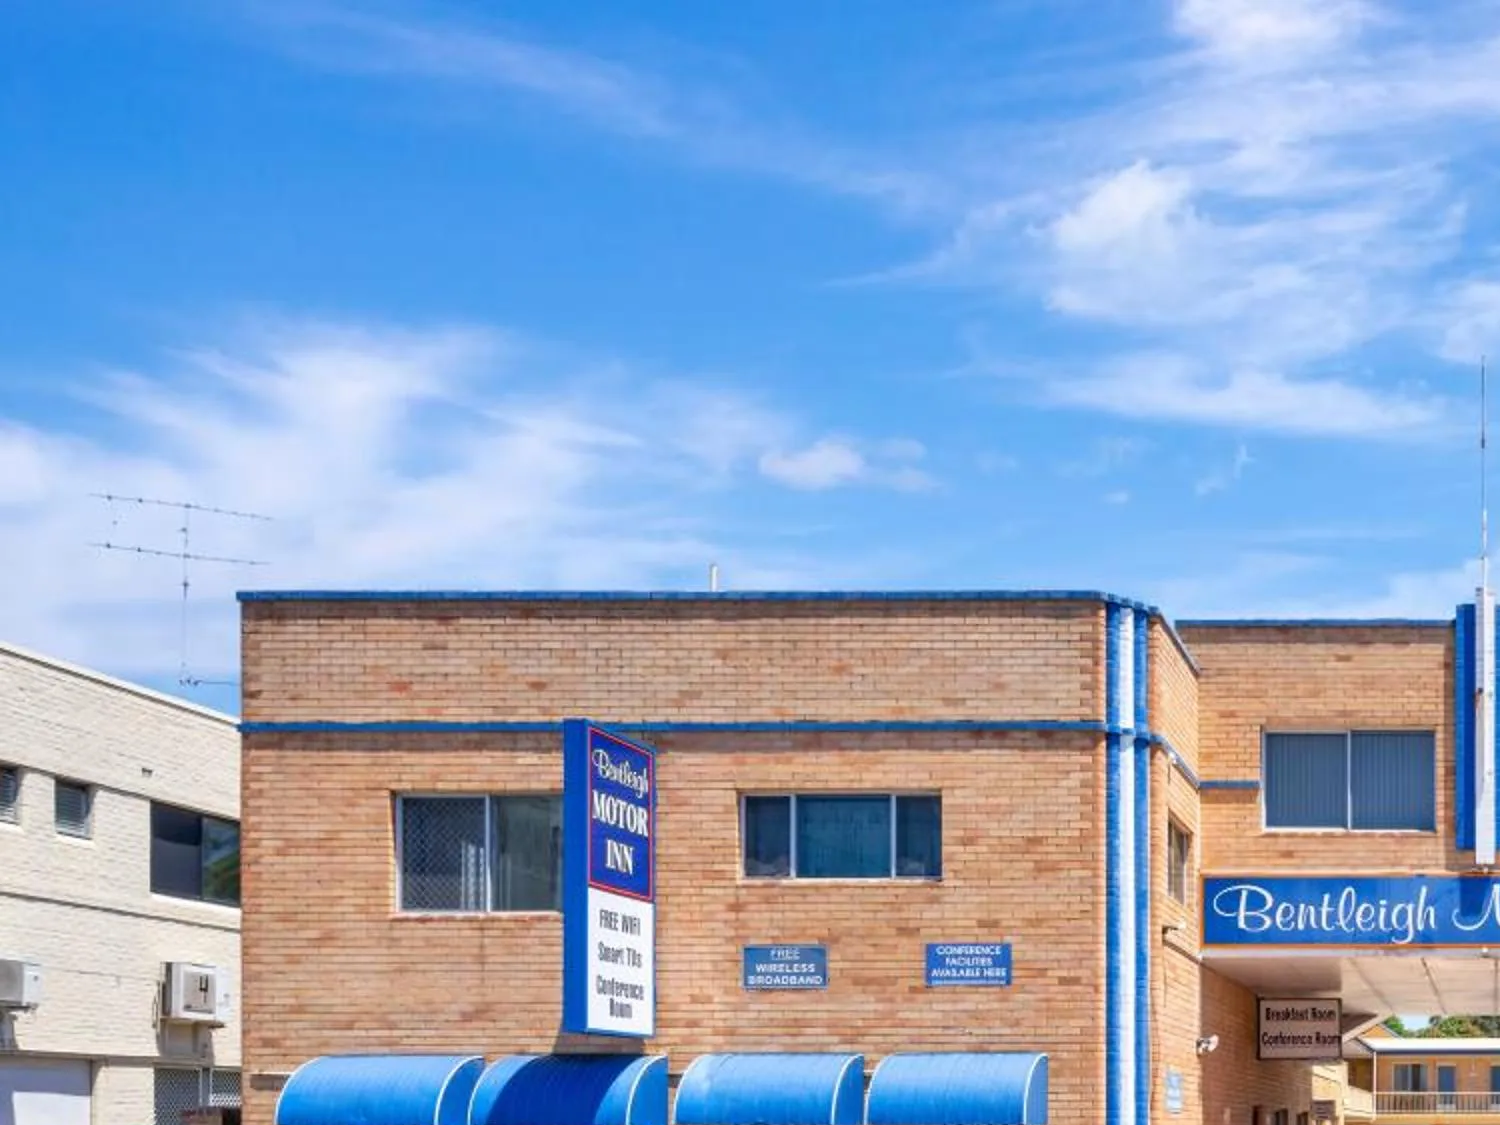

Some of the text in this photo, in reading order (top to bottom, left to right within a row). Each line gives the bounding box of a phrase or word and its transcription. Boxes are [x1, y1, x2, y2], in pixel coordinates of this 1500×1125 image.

[592, 749, 649, 798] Bentleigh
[592, 789, 649, 837] MOTOR
[605, 839, 634, 874] INN
[599, 908, 619, 931] FREE
[1213, 884, 1436, 944] Bentleigh
[598, 940, 625, 965] Smart
[935, 945, 1002, 955] CONFERENCE
[755, 963, 816, 973] WIRELESS
[931, 967, 1007, 977] AVAILABLE HERE
[596, 974, 644, 1000] Conference
[747, 975, 823, 985] BROADBAND
[1265, 1007, 1309, 1021] Breakfast
[1261, 1031, 1341, 1046] Conference Room
